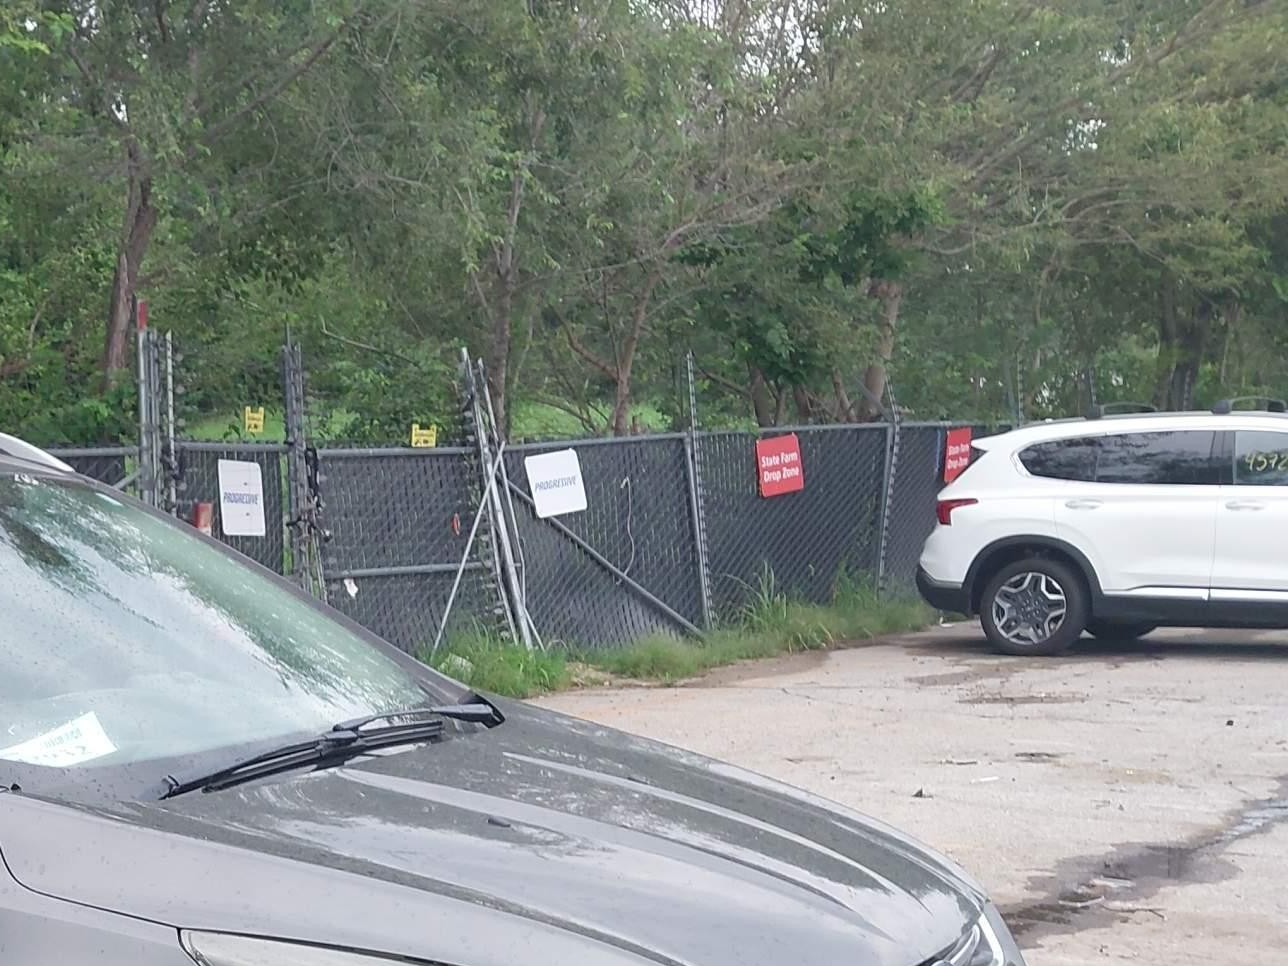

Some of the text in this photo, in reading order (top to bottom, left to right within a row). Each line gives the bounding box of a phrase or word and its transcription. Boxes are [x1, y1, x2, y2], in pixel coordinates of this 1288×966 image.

[761, 452, 798, 468] State Farm
[763, 466, 799, 483] Drop Zone
